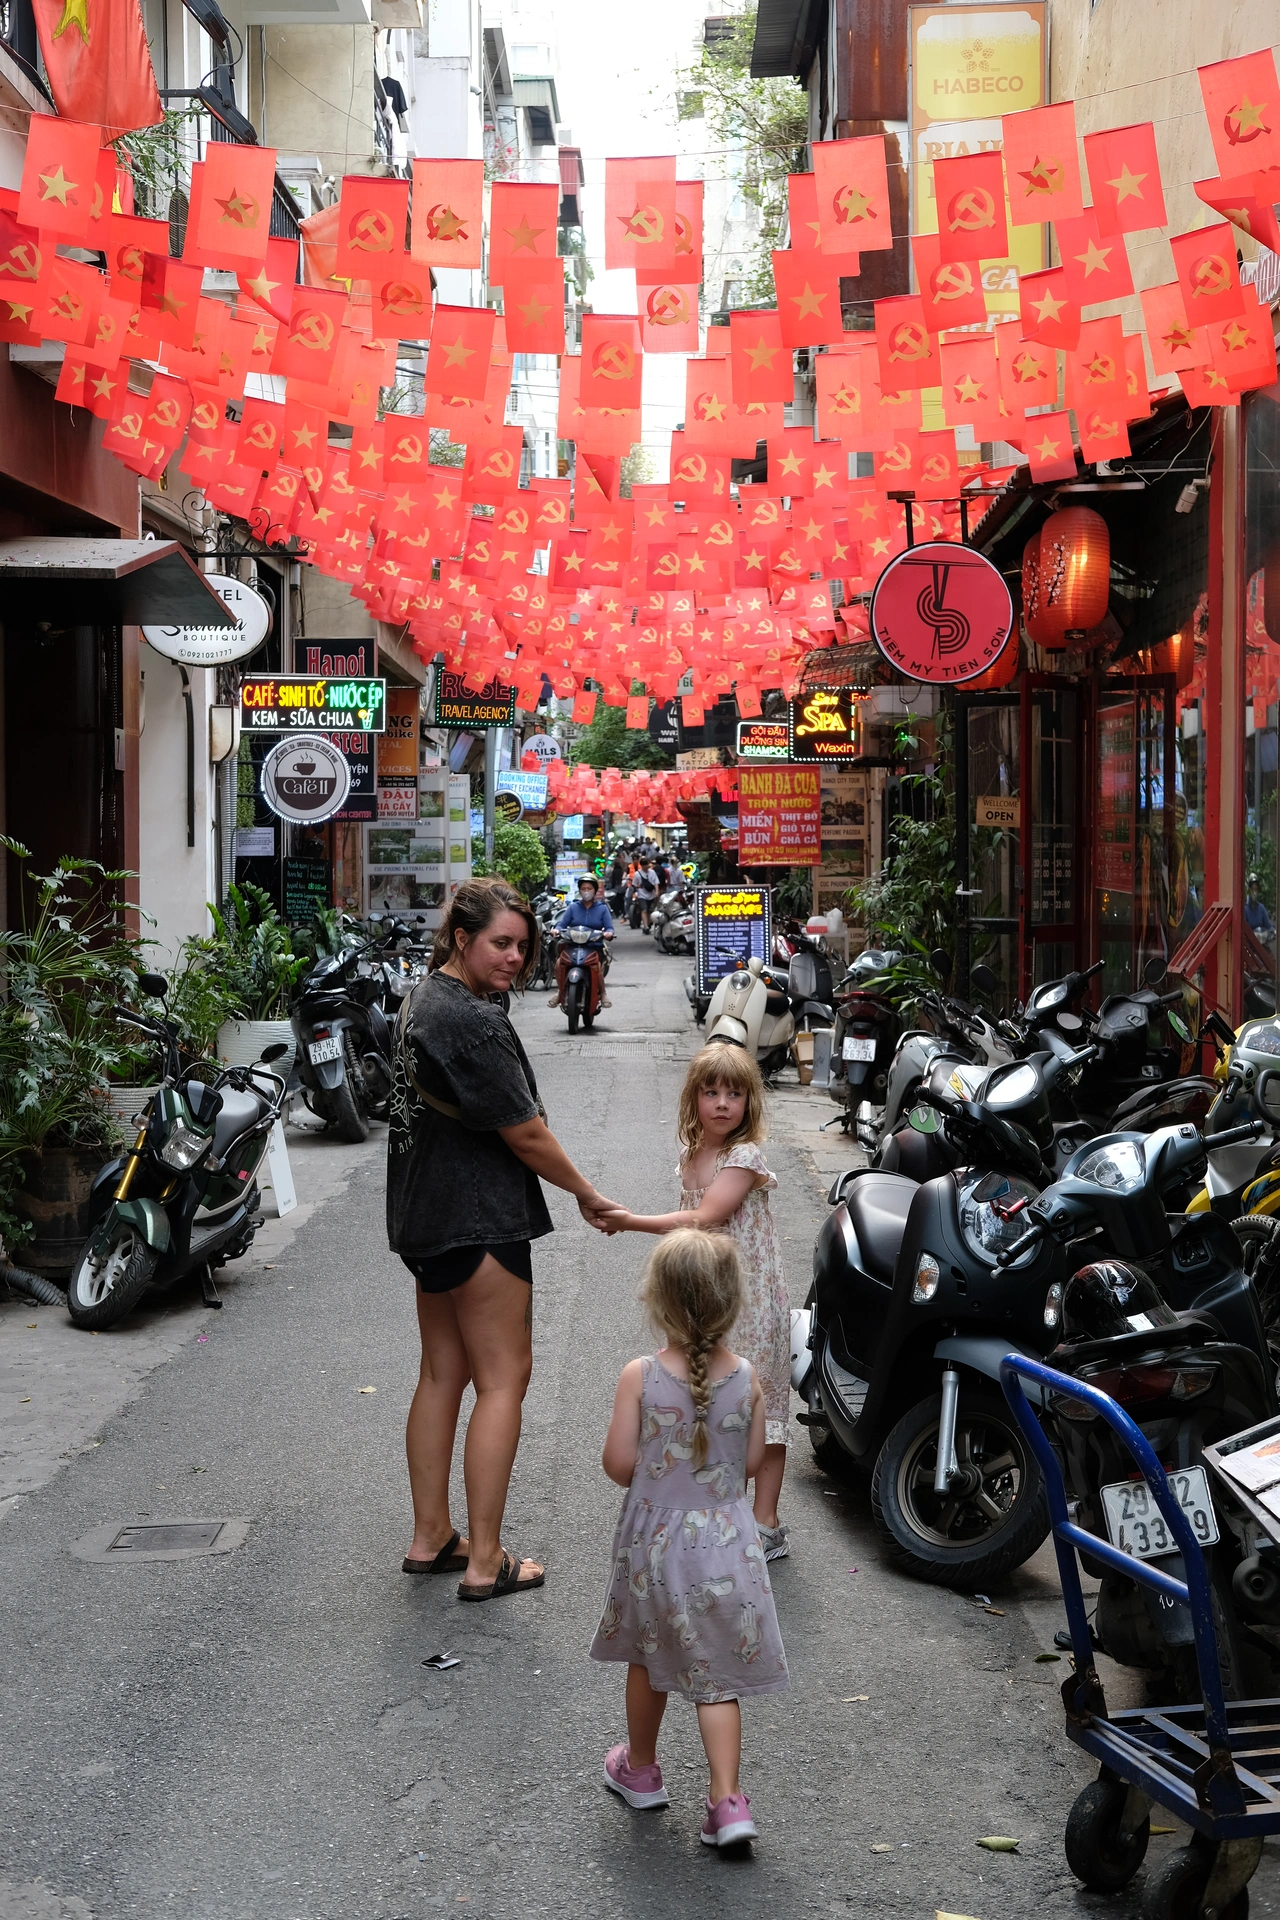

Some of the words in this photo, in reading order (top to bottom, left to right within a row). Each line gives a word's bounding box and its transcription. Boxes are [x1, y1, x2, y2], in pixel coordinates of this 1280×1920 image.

[933, 76, 1024, 95] HABECO
[306, 645, 366, 677] Hanoi
[242, 681, 275, 707] CAFÉ
[278, 685, 306, 707] SINH
[368, 682, 384, 708] ÉP
[252, 710, 279, 726] KEM
[289, 707, 316, 726] SỮA
[318, 711, 354, 727] CHUA
[441, 704, 472, 718] TRAVEL
[473, 705, 510, 720] AGENCY
[388, 715, 414, 728] NG
[796, 706, 847, 736] SPA
[320, 733, 370, 755] stel
[774, 737, 788, 746] SIN
[815, 743, 855, 753] Waxin
[282, 778, 318, 795] Café
[350, 779, 362, 788] 69
[500, 773, 526, 783] BOOKING
[527, 775, 547, 785] OFFICE
[741, 768, 773, 795] BÁNH
[794, 772, 818, 795] CUA
[983, 799, 1018, 808] WELLCOME
[986, 810, 1014, 821] OPEN
[801, 824, 816, 833] TAI
[744, 829, 771, 844] BÚN
[312, 1048, 341, 1064] 310.54
[844, 1049, 873, 1060] 263.34
